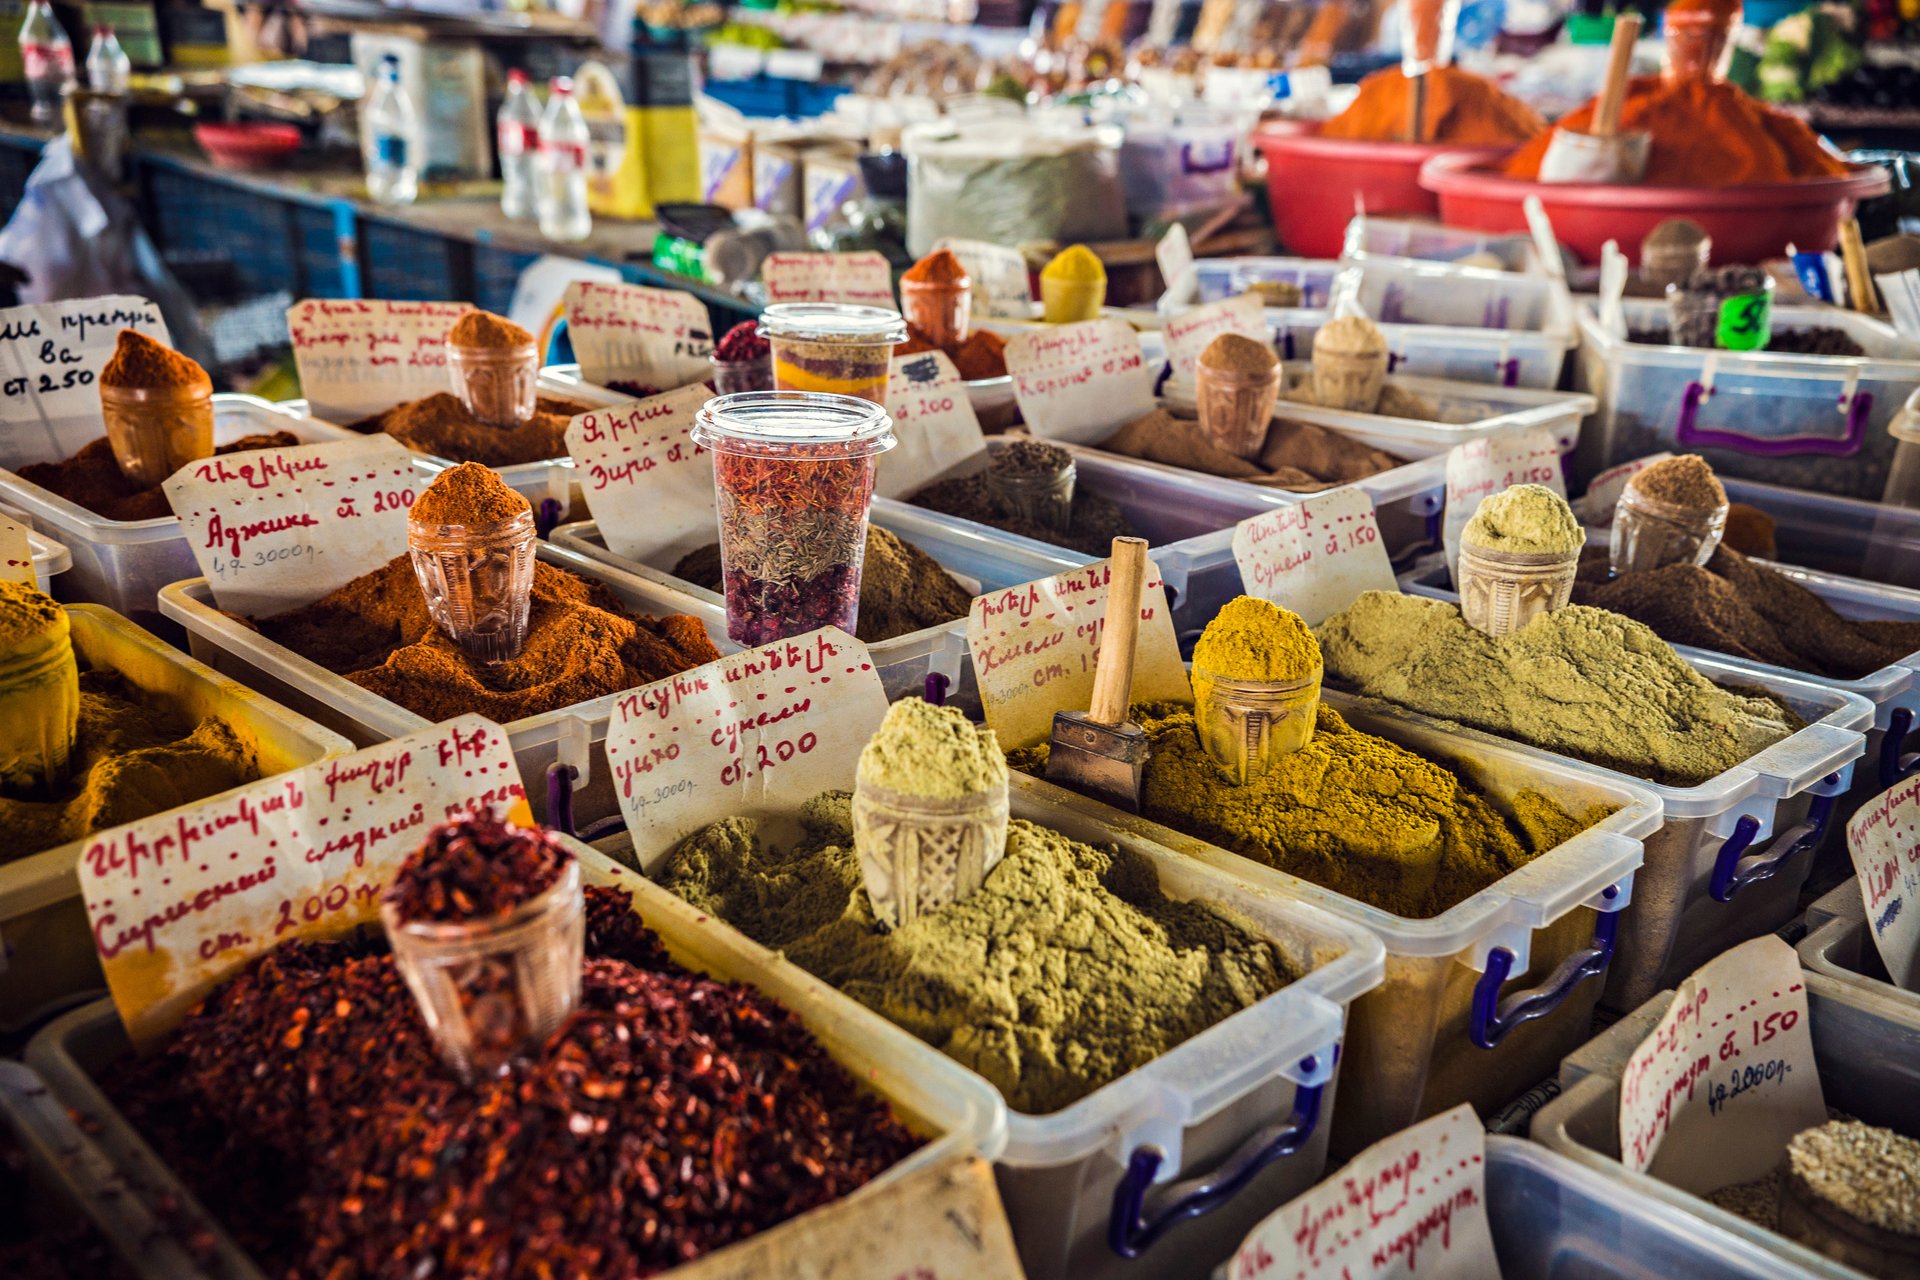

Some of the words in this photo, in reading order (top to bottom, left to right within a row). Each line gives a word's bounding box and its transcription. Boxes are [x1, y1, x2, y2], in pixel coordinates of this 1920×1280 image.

[39, 340, 83, 364] ва
[39, 370, 94, 393] 250
[919, 397, 954, 416] 200
[590, 456, 657, 490] Зира
[1522, 467, 1553, 484] 150
[373, 488, 416, 513] 200
[1254, 550, 1312, 588] Сунели
[1349, 526, 1376, 548] 150
[978, 631, 1064, 676] Хмели
[756, 731, 817, 771] 200
[1753, 1010, 1798, 1046] 150
